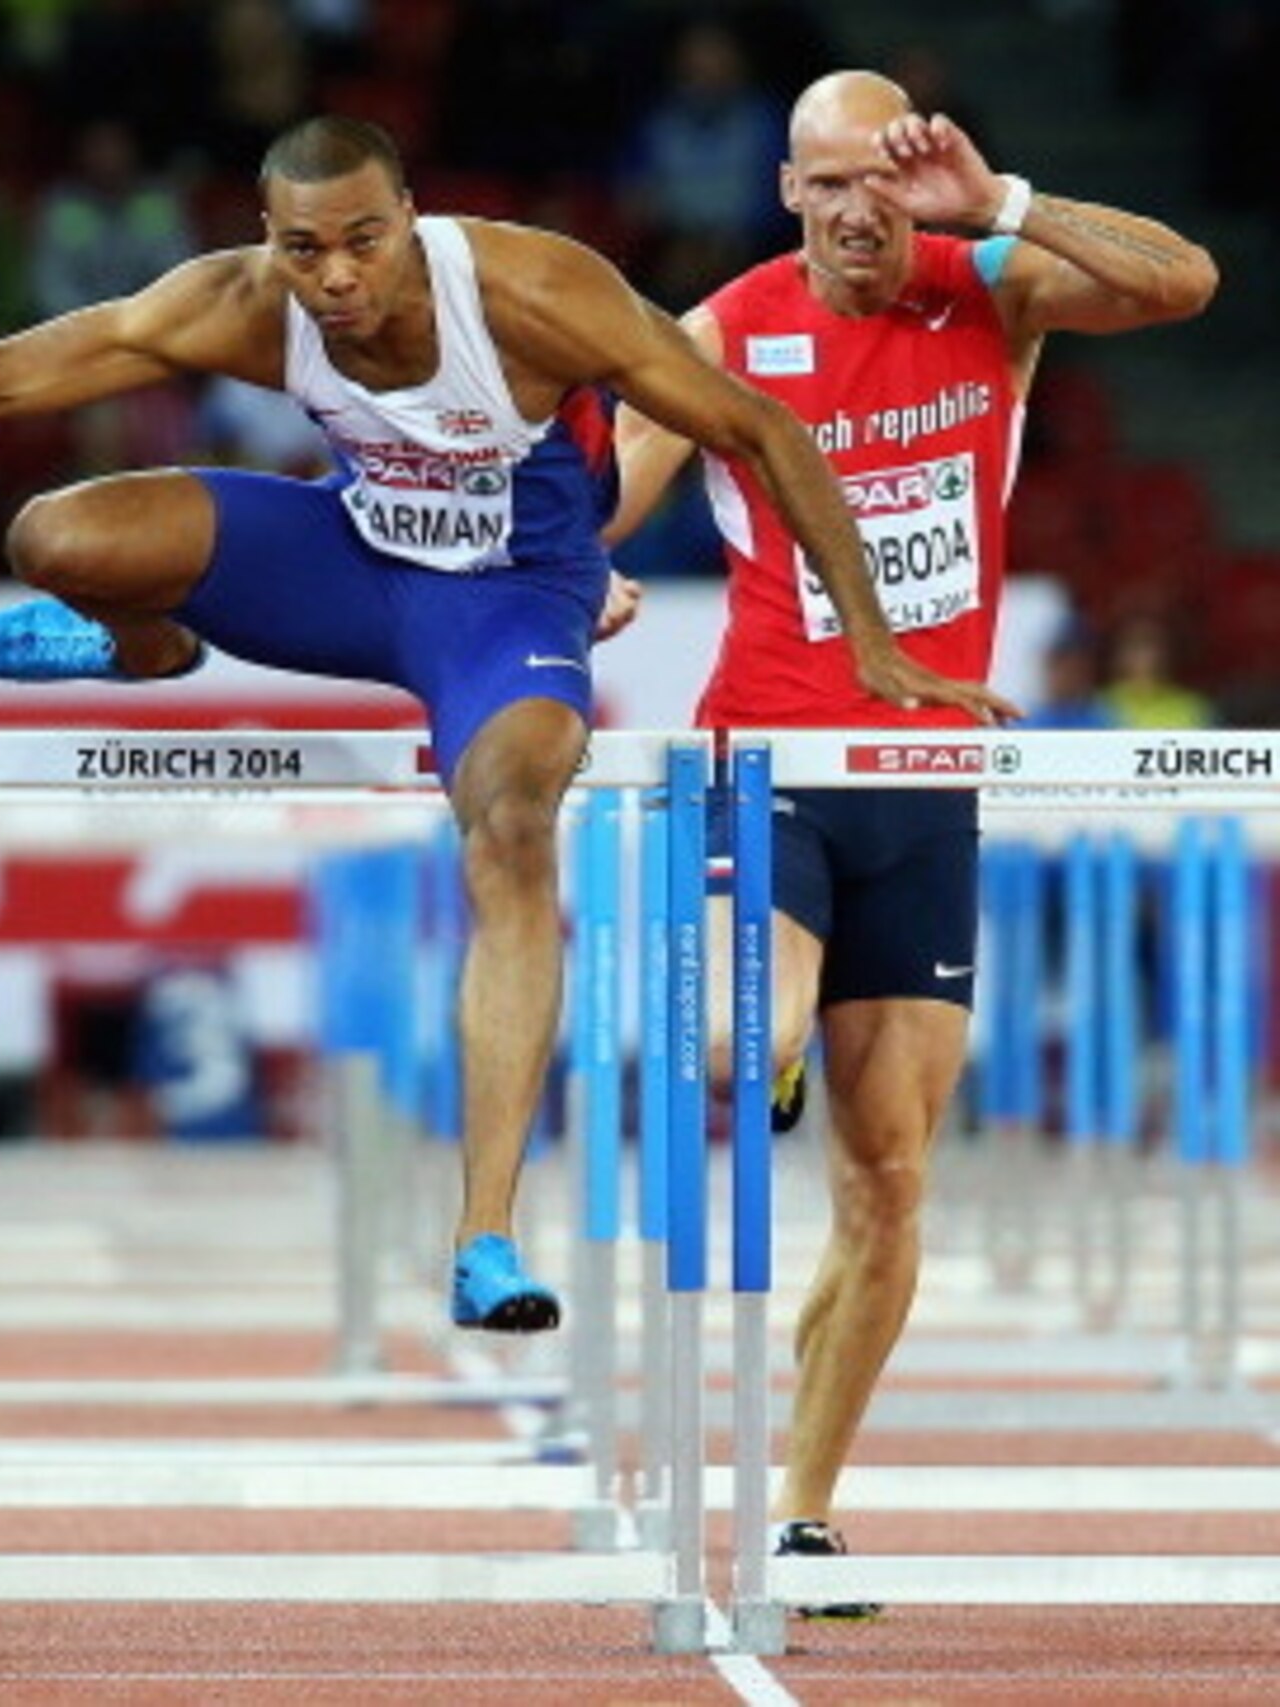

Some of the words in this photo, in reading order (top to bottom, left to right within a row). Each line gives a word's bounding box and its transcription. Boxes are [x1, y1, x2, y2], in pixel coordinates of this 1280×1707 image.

[810, 410, 852, 453] ch
[865, 382, 991, 448] republic
[365, 455, 455, 488] PAR
[844, 474, 931, 513] PAR
[370, 503, 504, 547] ARMAN
[76, 740, 215, 778] ZÜRICH
[228, 748, 302, 778] 2014
[877, 748, 983, 770] SPAR
[1134, 740, 1272, 777] ZÜRICH
